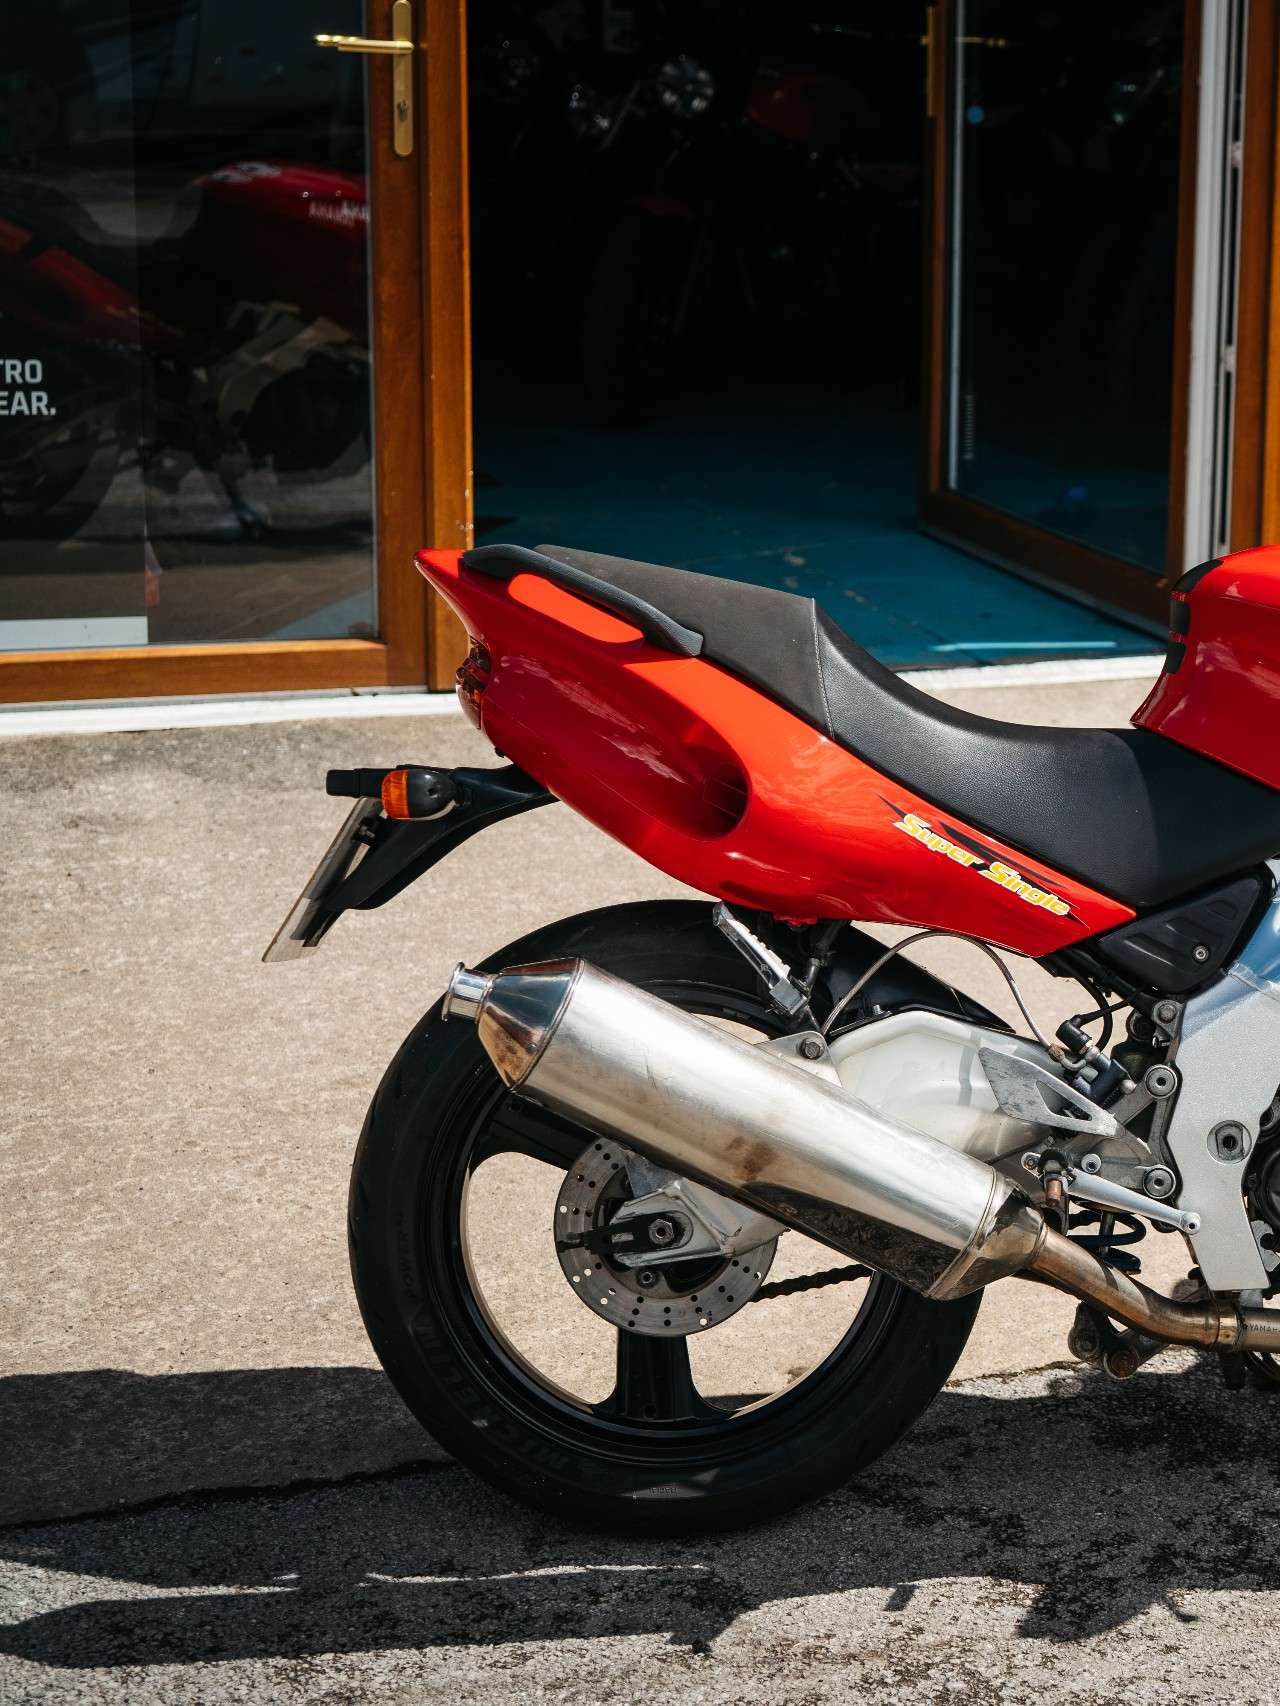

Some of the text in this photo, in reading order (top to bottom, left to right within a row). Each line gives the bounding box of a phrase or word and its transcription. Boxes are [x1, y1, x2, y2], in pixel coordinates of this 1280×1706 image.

[0, 358, 43, 384] RO
[892, 813, 1071, 916] Super Single
